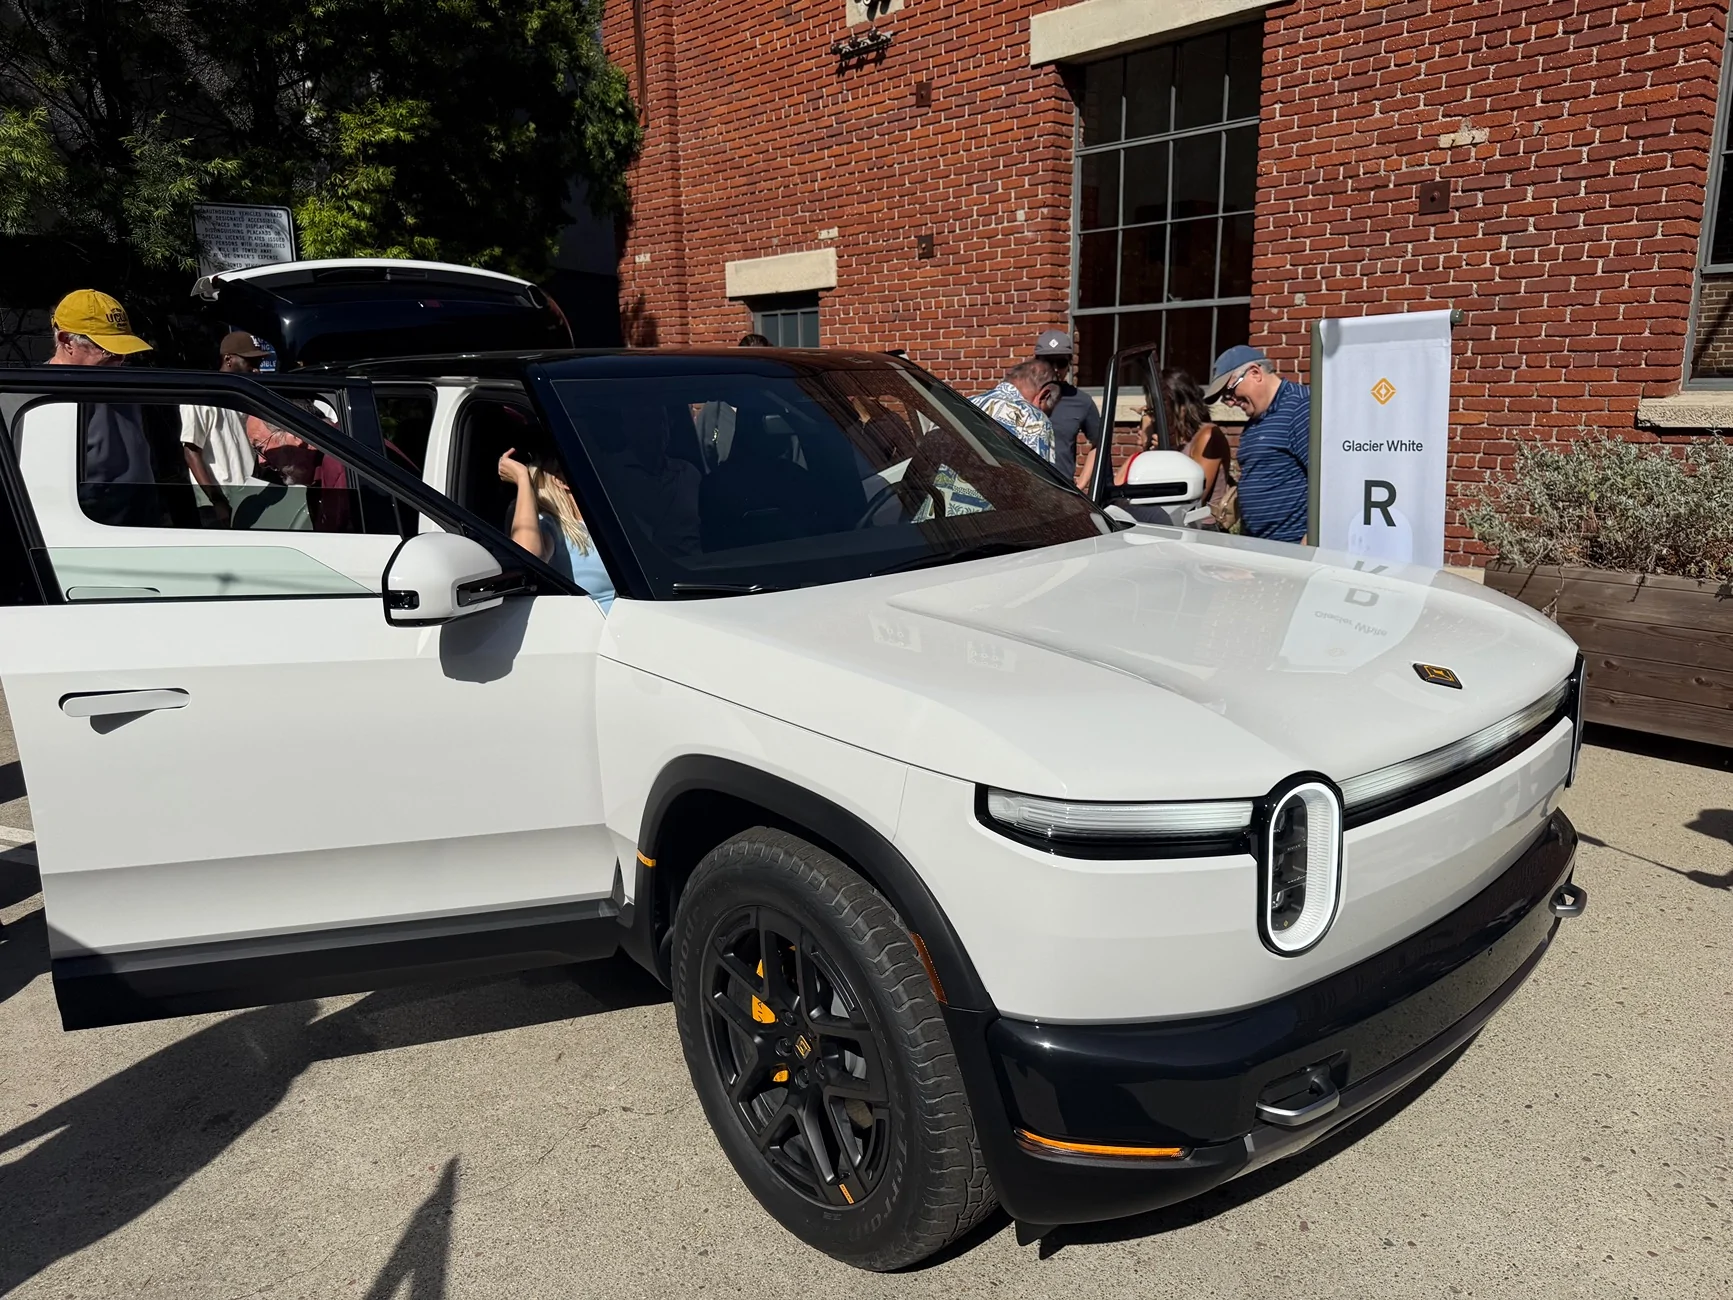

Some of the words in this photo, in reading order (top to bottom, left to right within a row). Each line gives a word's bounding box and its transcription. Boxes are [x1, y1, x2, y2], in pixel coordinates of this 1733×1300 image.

[1342, 440, 1384, 452] Glacier
[1386, 440, 1423, 452] White
[1364, 479, 1397, 527] R
